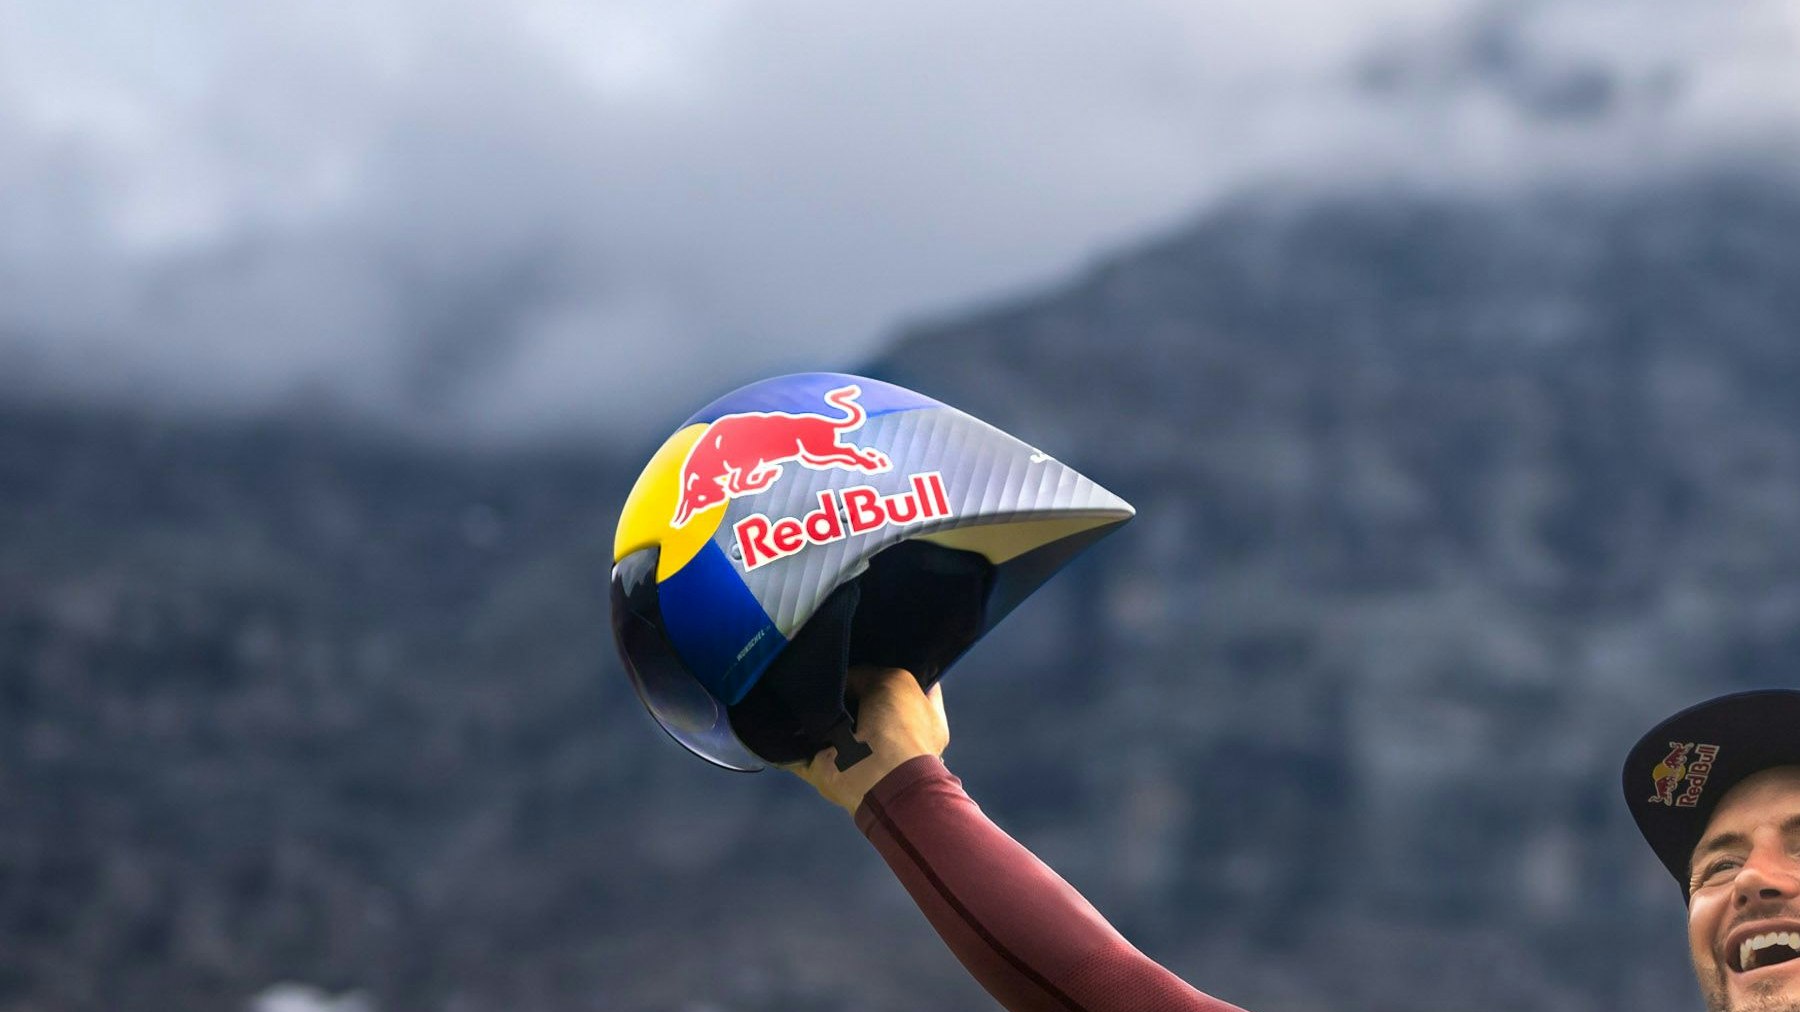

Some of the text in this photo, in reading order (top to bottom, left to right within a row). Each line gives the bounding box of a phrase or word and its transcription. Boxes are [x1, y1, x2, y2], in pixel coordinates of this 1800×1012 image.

[737, 475, 949, 568] Red Bull
[1677, 745, 1719, 806] Red Bull
